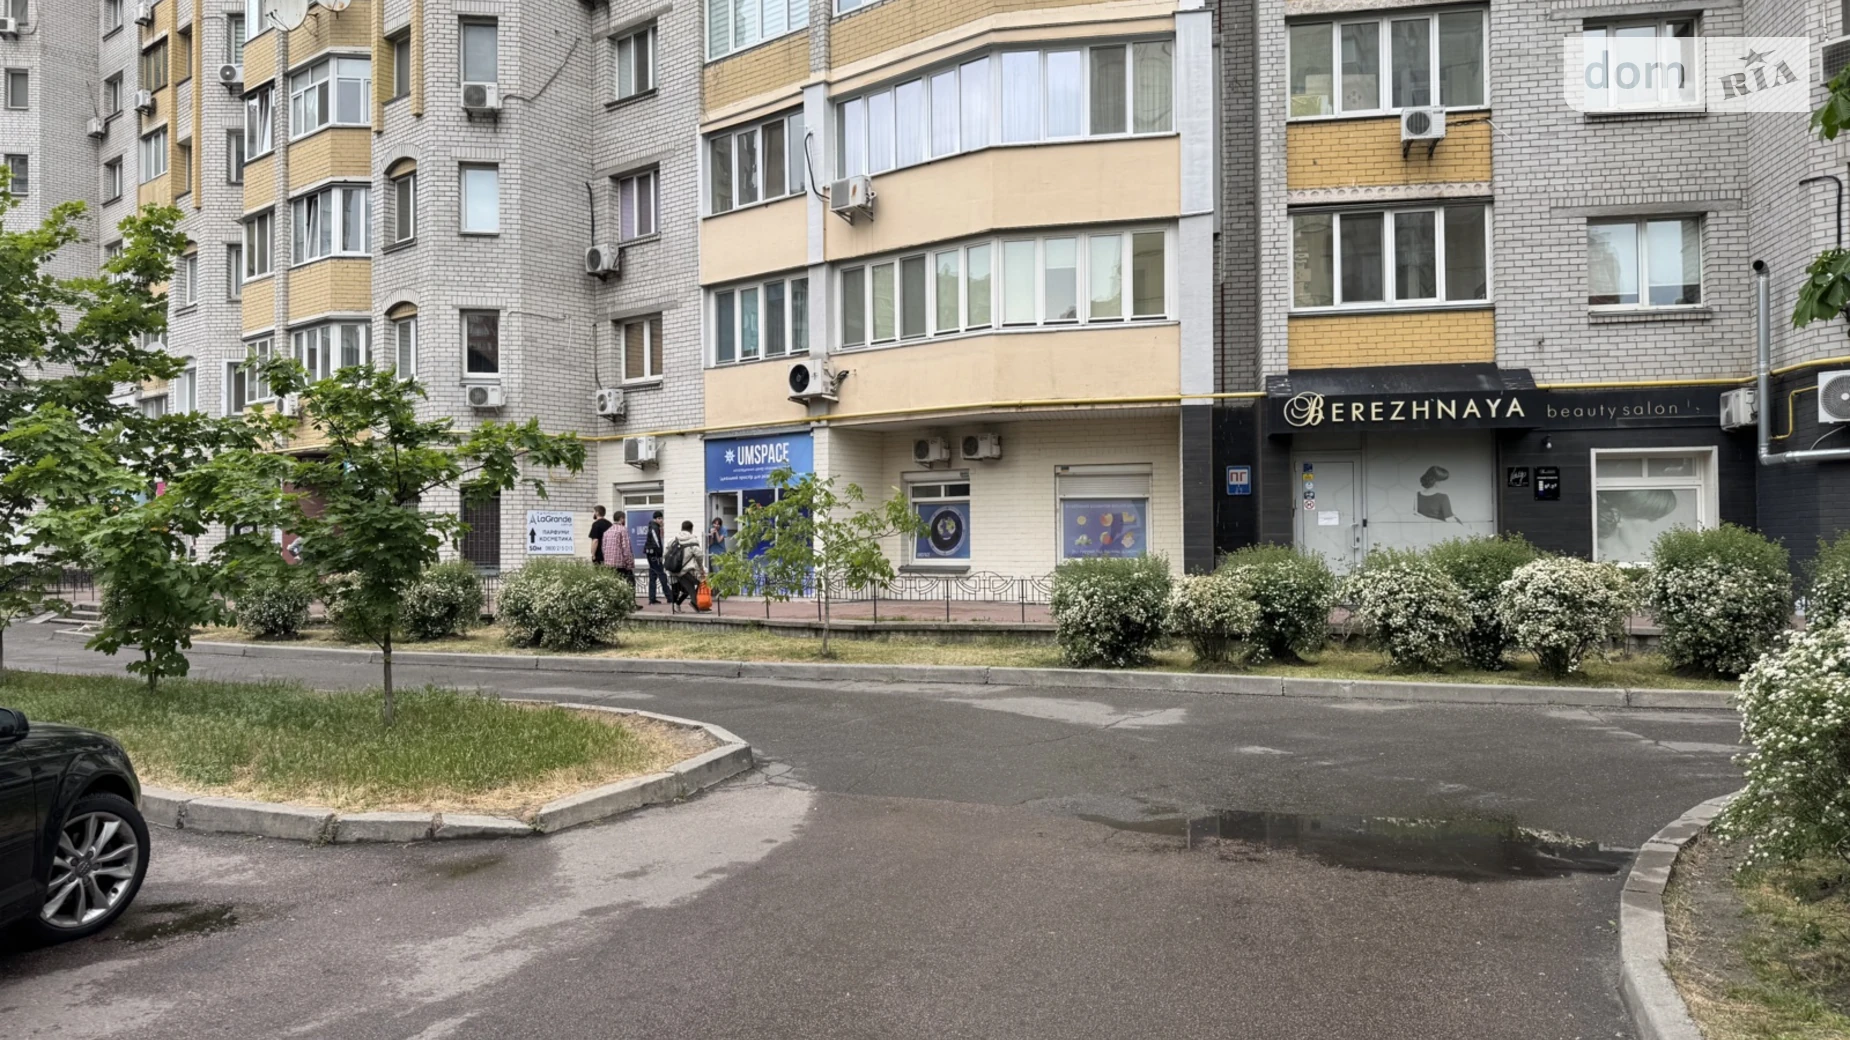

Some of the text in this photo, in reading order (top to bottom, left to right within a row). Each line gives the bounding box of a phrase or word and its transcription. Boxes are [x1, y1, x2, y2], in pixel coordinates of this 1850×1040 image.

[1283, 391, 1525, 427] BEREZHNAYA
[1547, 403, 1617, 419] beauty
[1622, 401, 1678, 416] salon
[737, 442, 790, 466] UMSPACE
[1230, 471, 1247, 482] ПГ
[537, 515, 572, 523] LaGrande
